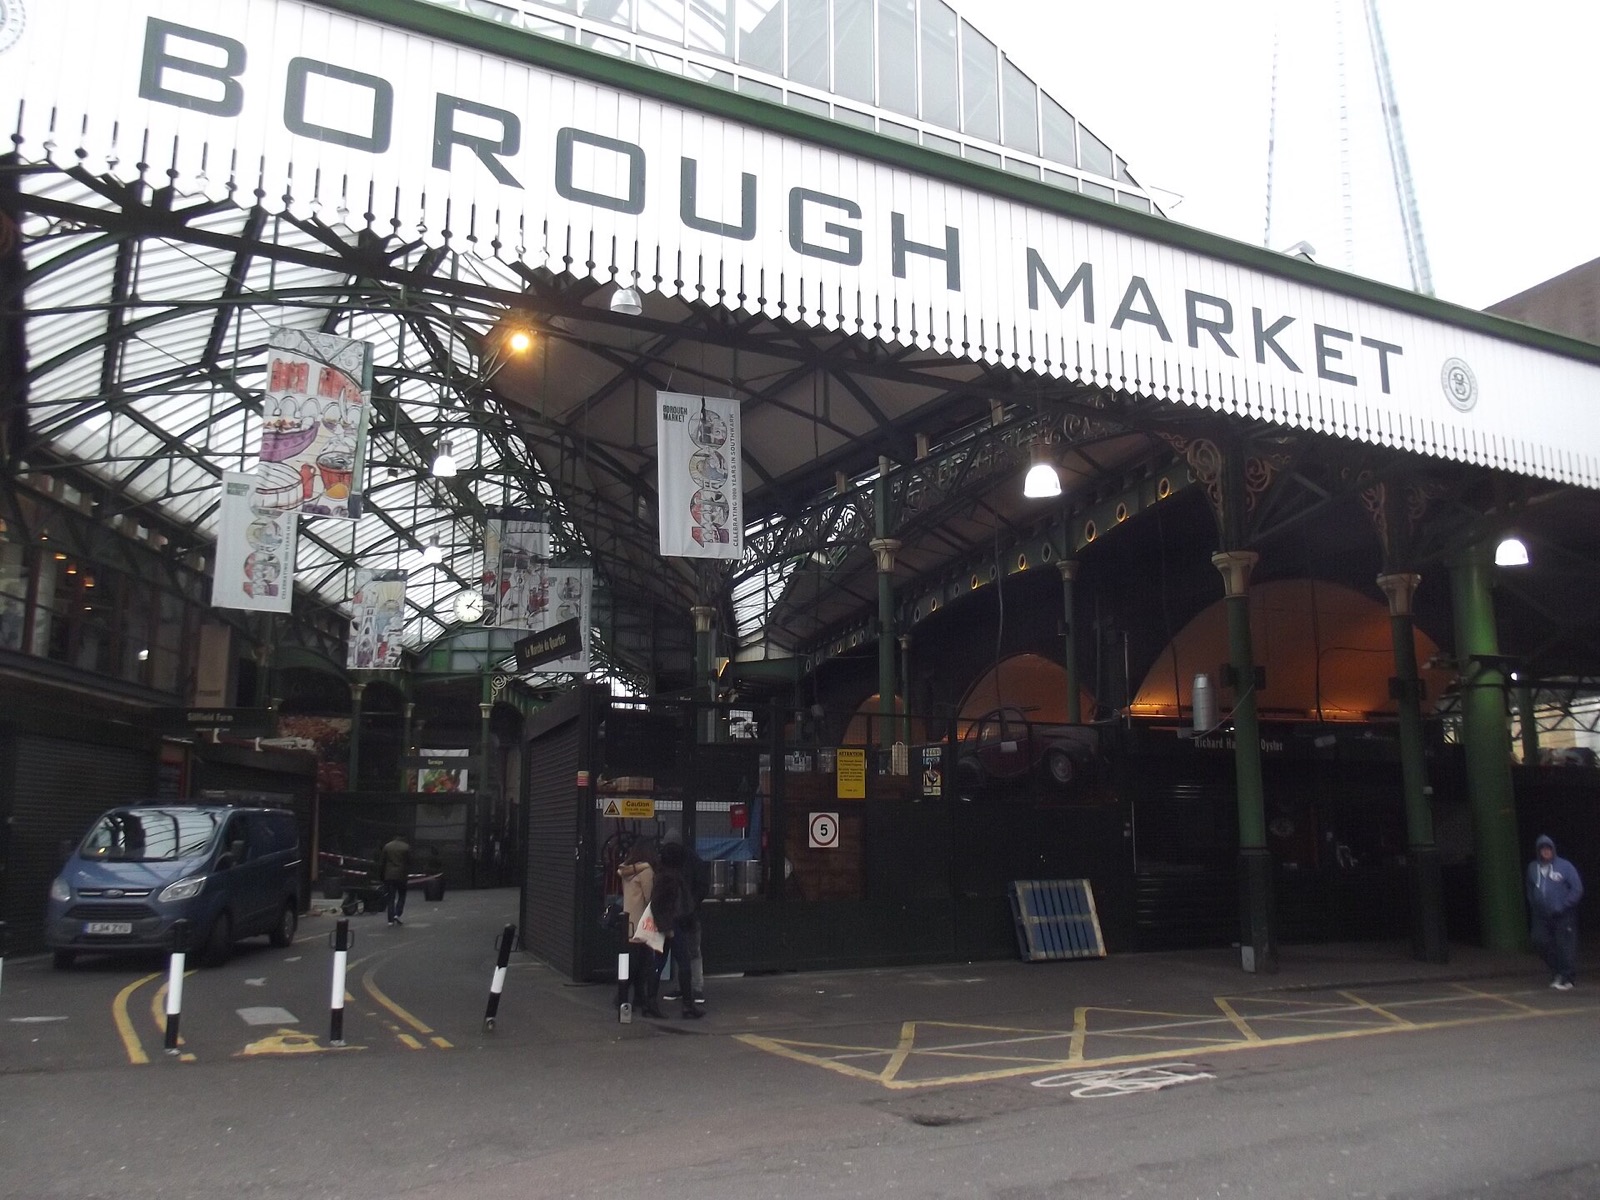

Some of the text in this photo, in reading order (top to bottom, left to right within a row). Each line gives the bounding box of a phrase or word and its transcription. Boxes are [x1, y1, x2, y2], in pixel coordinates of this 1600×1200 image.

[139, 17, 1403, 394] BOROUGH MARKET
[663, 405, 688, 416] BOROUGH
[663, 413, 686, 423] MARKET
[730, 456, 736, 464] IN
[1194, 737, 1223, 749] Richard
[820, 824, 828, 836] 5
